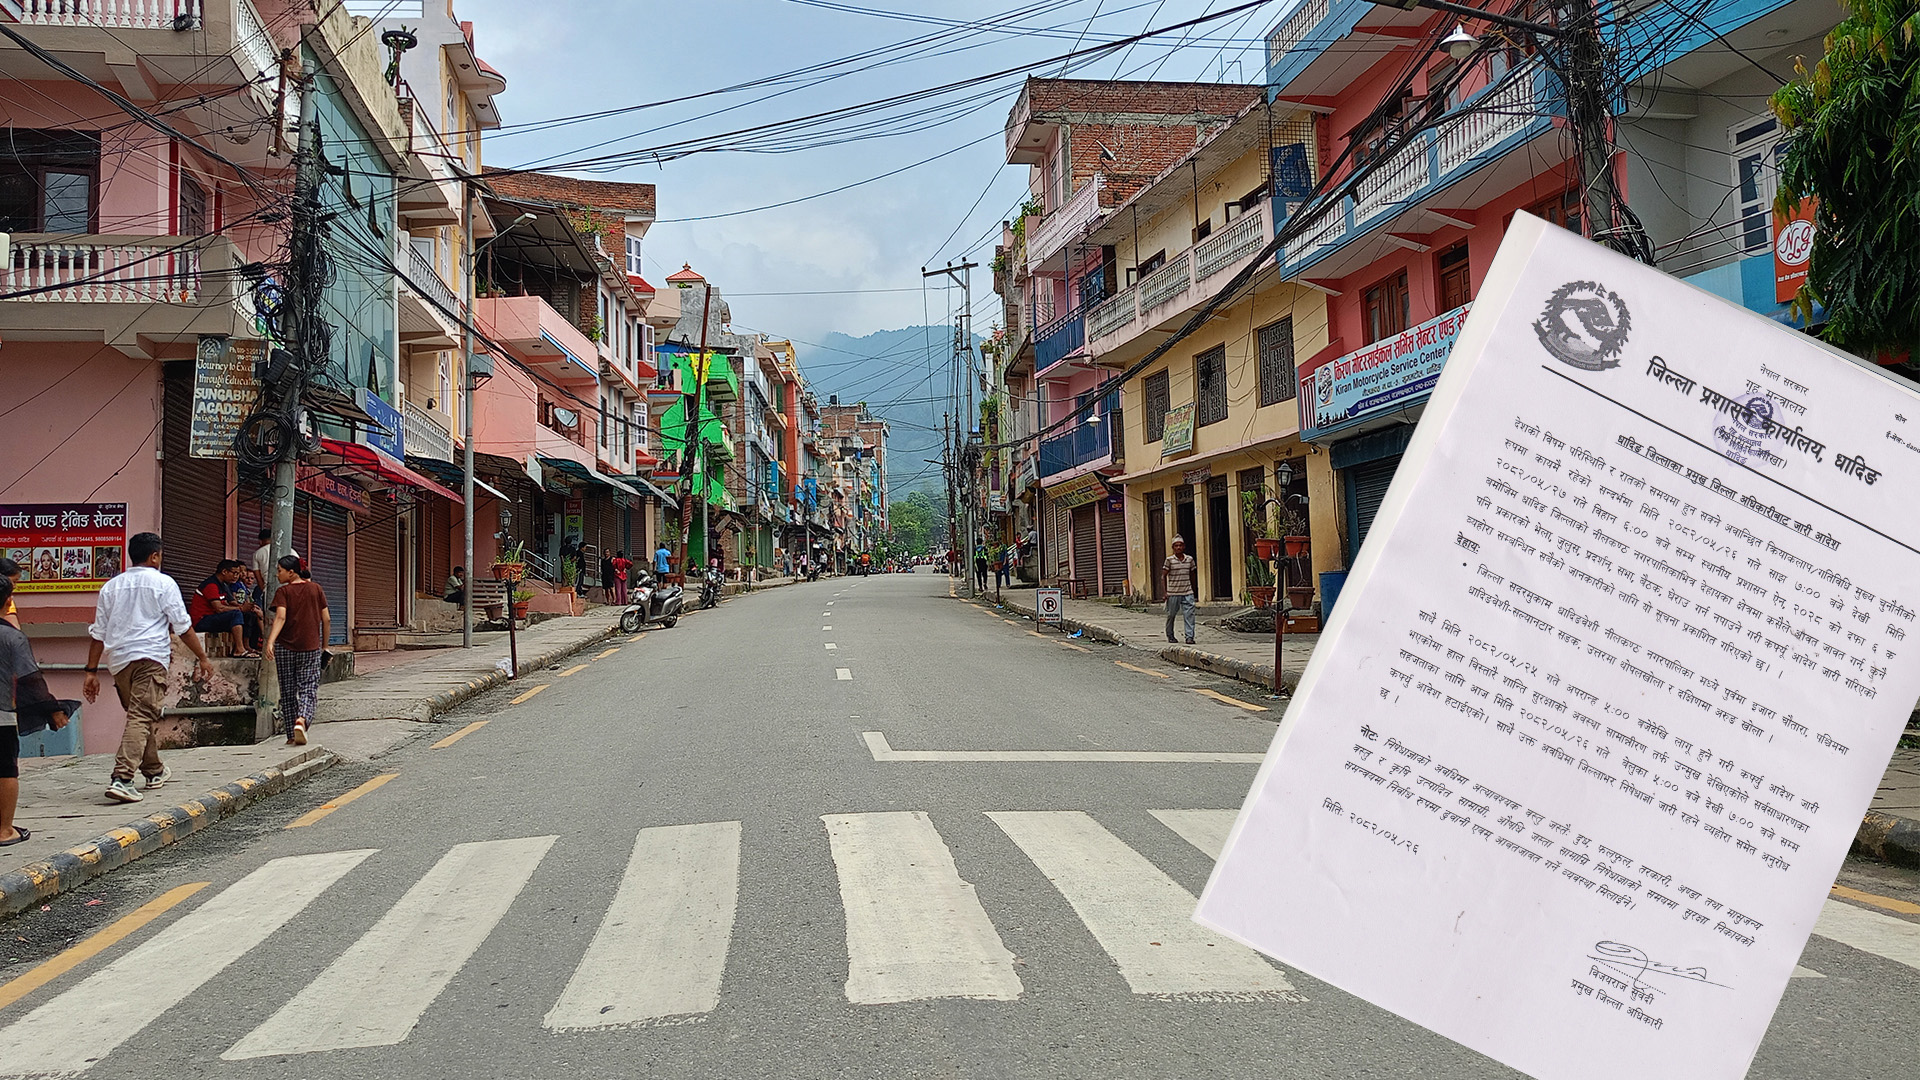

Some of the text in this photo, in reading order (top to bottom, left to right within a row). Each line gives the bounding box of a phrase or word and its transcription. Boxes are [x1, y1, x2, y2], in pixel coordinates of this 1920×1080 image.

[194, 388, 259, 402] SUNGABHA
[197, 359, 229, 375] Journey
[229, 362, 236, 371] to
[199, 373, 225, 388] through
[1333, 360, 1351, 382] किरण
[1415, 324, 1437, 349] सेन्टर
[1438, 317, 1455, 340] एण्ड
[1335, 381, 1352, 396] Kiran
[1352, 369, 1390, 389] Motorcycle
[1390, 357, 1418, 375] Service
[1419, 346, 1446, 365] Center
[1741, 378, 1807, 417] गृह मन्त्रालय
[1760, 363, 1810, 397] नेपाल सरकार
[1646, 355, 1697, 396] जिल्ला
[1699, 386, 1755, 426] प्रशासन
[1758, 411, 1831, 463] कार्यालय,
[1831, 447, 1885, 488] धादिङ
[0, 510, 124, 531] पार्लर एण्ड ट्रेनिङ सेन्टर
[1496, 457, 1823, 625] २०८२/०५/२७ सम्म स्थानीय प्रशासन २०२८
[1504, 438, 1907, 642] रुपमा कायमै रहेको सन्दर्भमा मिति २०८२/०५/२६ मिति
[1514, 415, 1917, 623] देशको परिस्थिति रातको समयमा सक्ने मुख्य चुनौतीको
[1617, 434, 1842, 551] धादिङ जिल्लाका प्रमुख जिल्ला अधिकारीबाट जारी आदेश
[1476, 563, 1720, 692] जिल्ला सदरमुकाम नीलकण्ठ नगरपालिका मध्ये
[1495, 505, 1878, 700] प्रकारको घेराउ गर्न नपाउने आदेश जारी गरिएको
[1497, 530, 1753, 663] सम्बन्धित जानकारीको लागि सूचना प्रकाशित गरिएको
[1549, 506, 1792, 634] जिल्लाको नीलकण्ठ नगरपालिकाभित्र देहायका कसैले
[1399, 648, 1801, 853] सहजताका लागि मिति २०८२/०५/२६ सम्म
[1409, 629, 1750, 804] भएकोमा शान्ति सुरक्षाको अवस्था तर्फ उन्मुख देखिएकोले
[1418, 609, 1820, 815] साथै मिति २०८२/०५/२५ लागू हुने आदेश जारी
[1587, 643, 1765, 738] उत्तरमा थोपलखोला खोला
[1344, 760, 1597, 890] समन्वयमा रुपमा आवतजावत गर्ने व्यवस्था
[1349, 812, 1420, 856] २०८२/०५/२६
[1416, 681, 1791, 872] आदेश साथै उक्त जिल्लाभर जारी अनुरोध
[1416, 775, 1756, 948] उत्पादित जस्ता समयमा सुरक्षा निकायको
[1472, 783, 1764, 931] अत्यावश्यक अण्डा मासुजन्य
[1570, 978, 1664, 1031] प्रमुख जिल्ला अधिकारी
